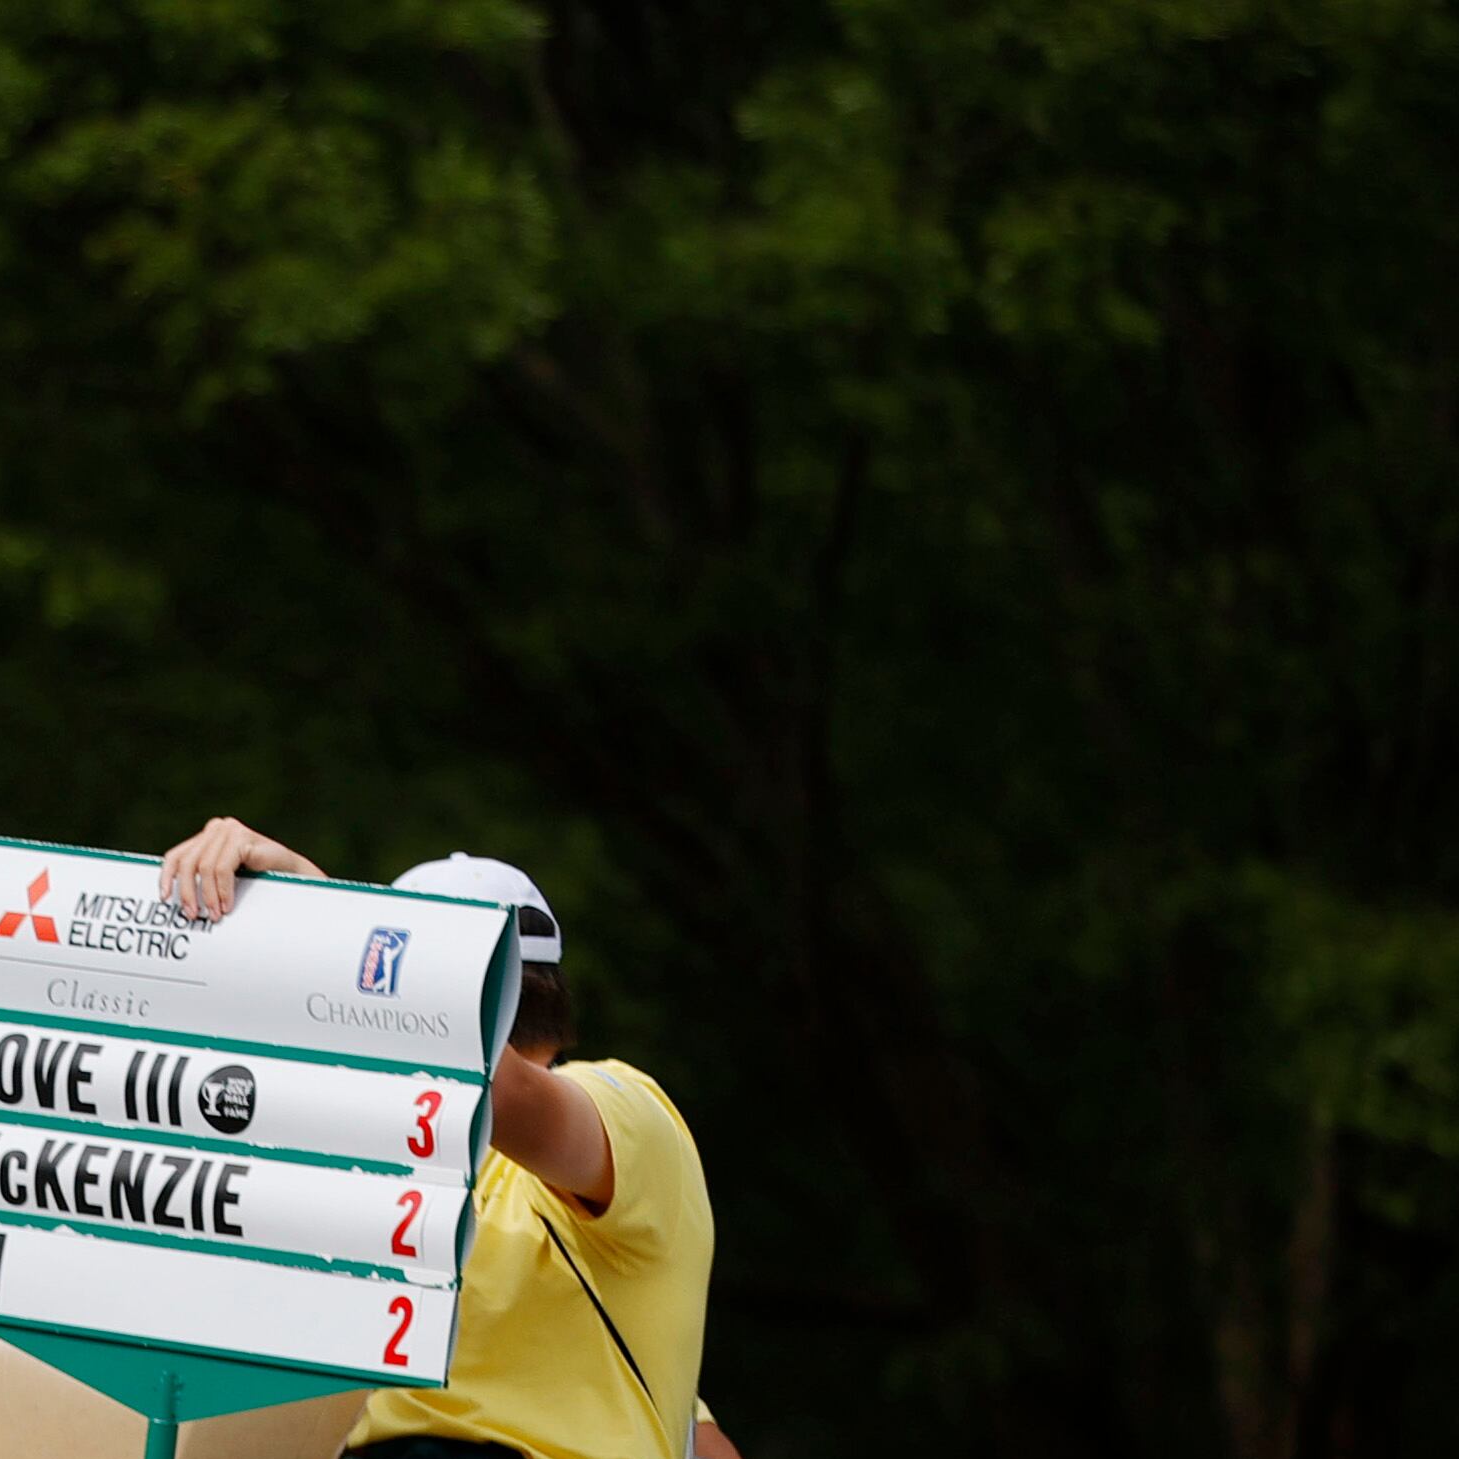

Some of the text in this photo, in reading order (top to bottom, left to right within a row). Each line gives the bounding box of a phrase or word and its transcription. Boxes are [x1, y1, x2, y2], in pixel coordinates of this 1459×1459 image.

[68, 920, 190, 961] ELECTRIC
[47, 977, 151, 1018] Classic
[306, 992, 450, 1040] CHAMPIONS
[124, 1050, 189, 1129] III
[407, 1090, 443, 1159] 3
[390, 1189, 423, 1258] 2
[383, 1295, 415, 1367] 2
